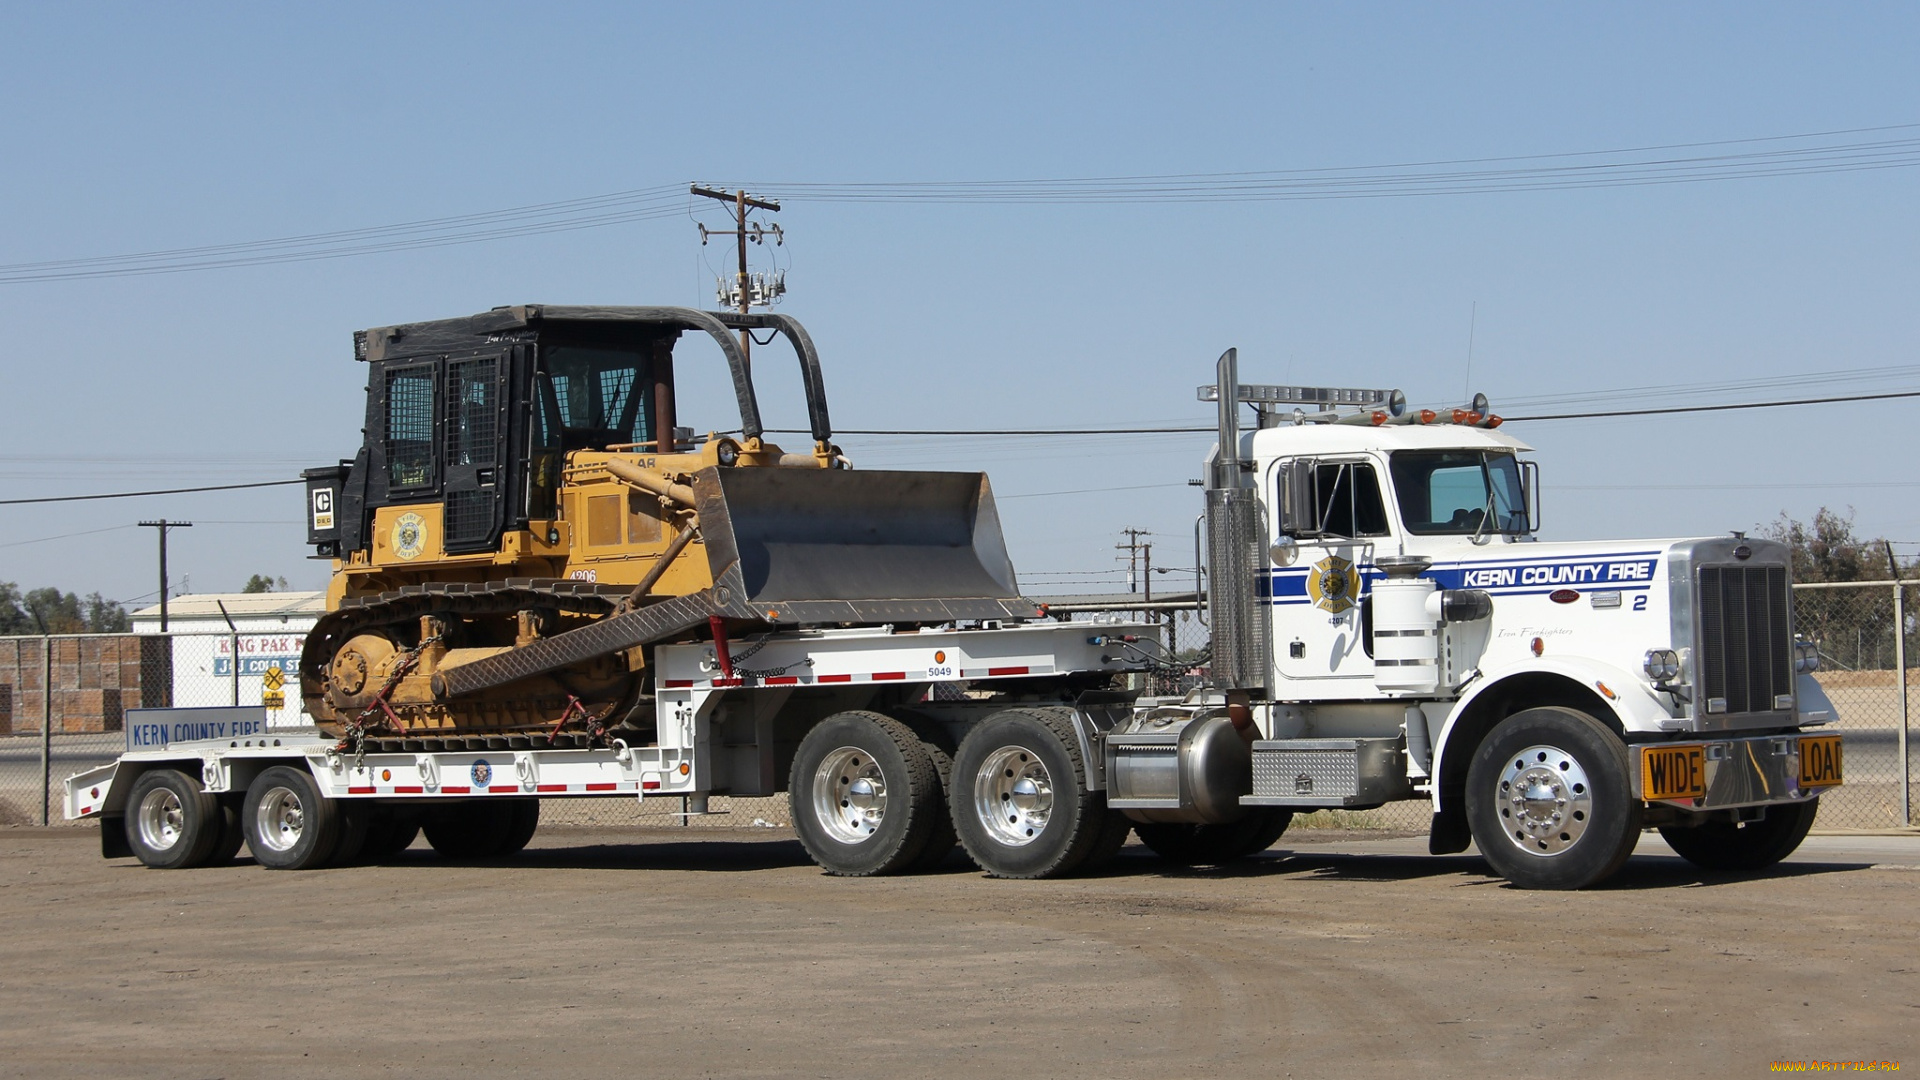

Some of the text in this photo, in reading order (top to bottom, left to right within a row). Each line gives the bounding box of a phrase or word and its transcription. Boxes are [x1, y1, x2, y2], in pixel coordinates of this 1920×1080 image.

[570, 569, 597, 583] 4206
[1463, 561, 1650, 587] KERN COUNTY FIRE
[1632, 595, 1648, 611] 2
[1328, 617, 1344, 625] 4207
[220, 639, 256, 653] KNG
[261, 638, 289, 652] PAK
[928, 667, 952, 677] 5049
[134, 723, 169, 746] KERN
[174, 721, 226, 742] COUNTY
[1648, 751, 1702, 795] WIDE
